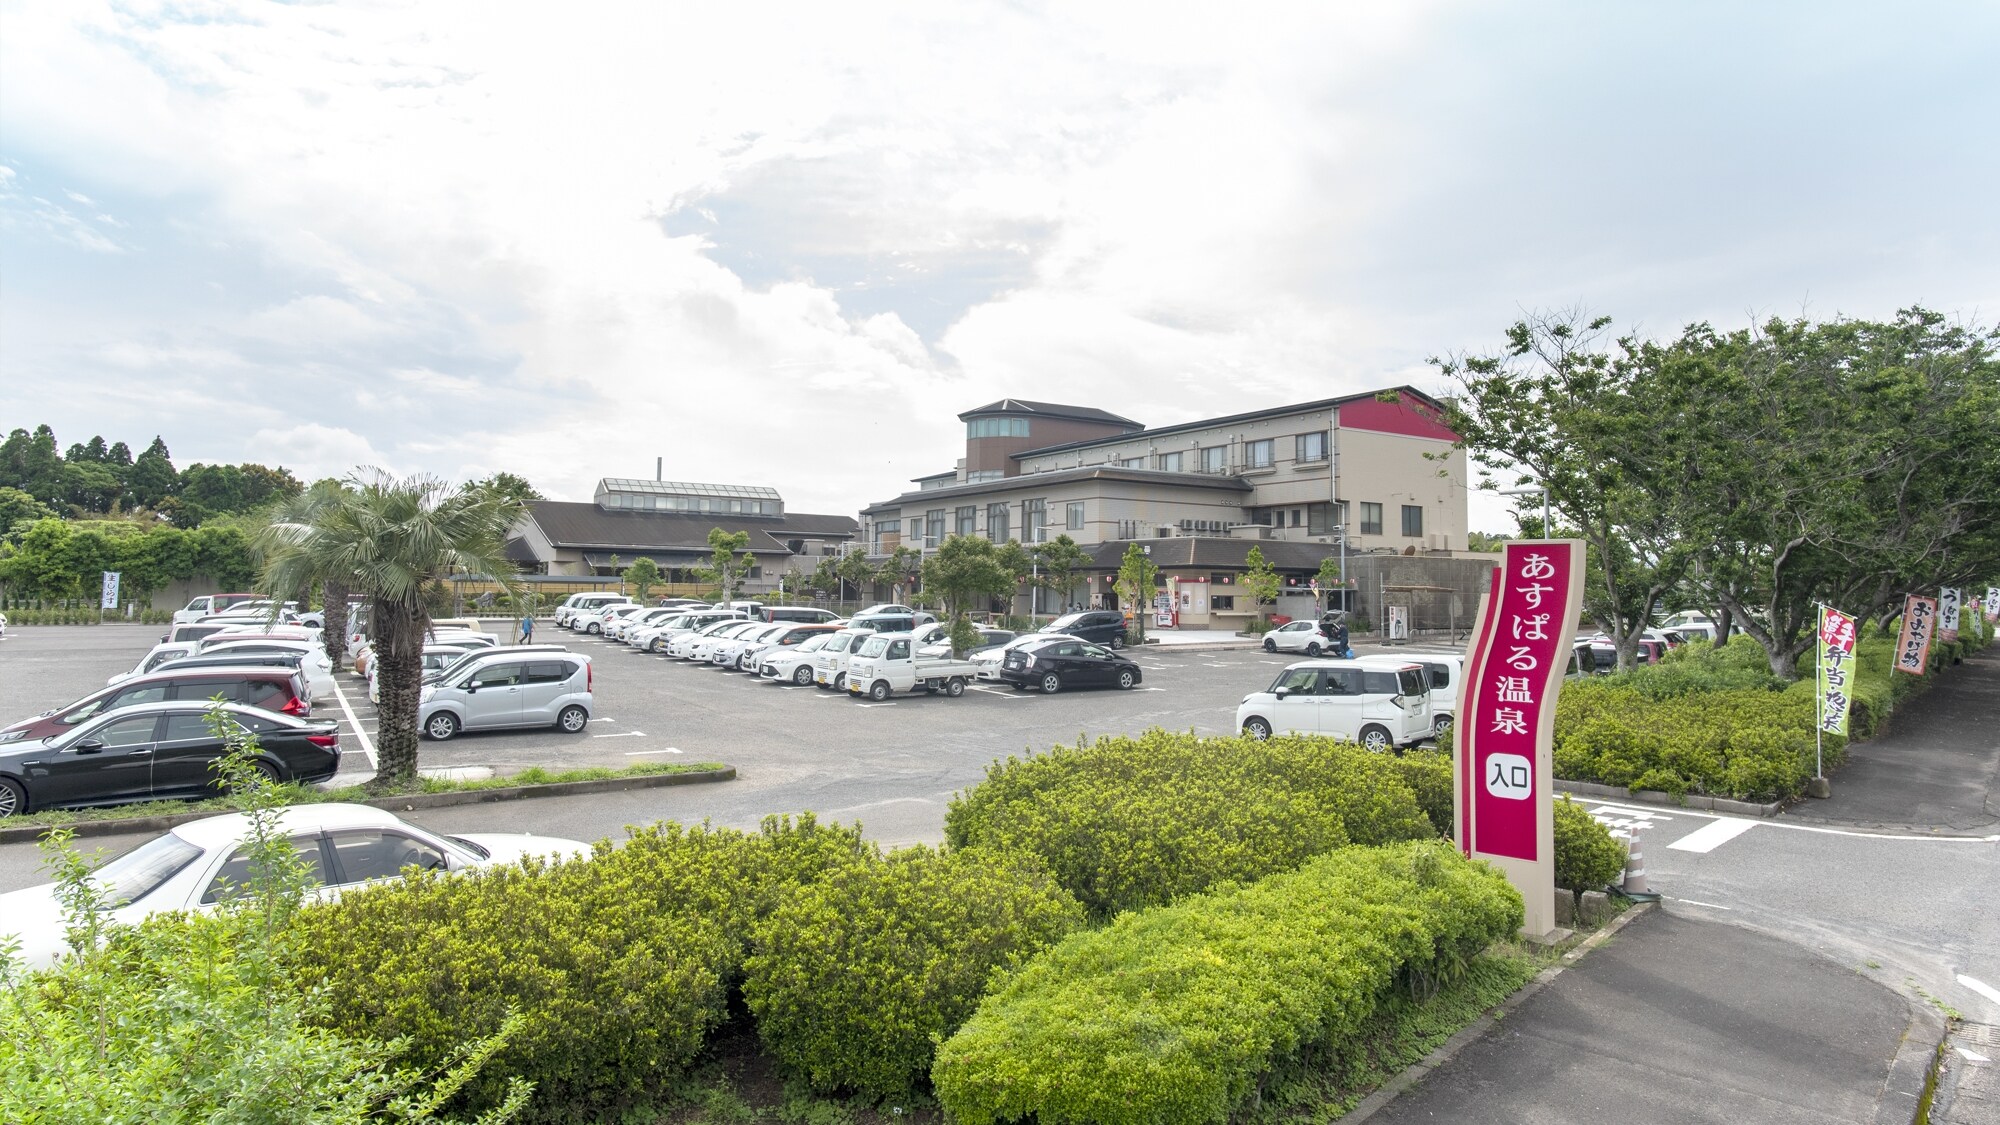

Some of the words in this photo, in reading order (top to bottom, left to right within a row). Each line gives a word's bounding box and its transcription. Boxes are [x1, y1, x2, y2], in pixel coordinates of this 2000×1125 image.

[106, 574, 116, 604] 生しらす
[1490, 553, 1555, 735] あすぱる温泉
[1901, 601, 1931, 667] おみやげ物
[1490, 763, 1528, 789] 入口
